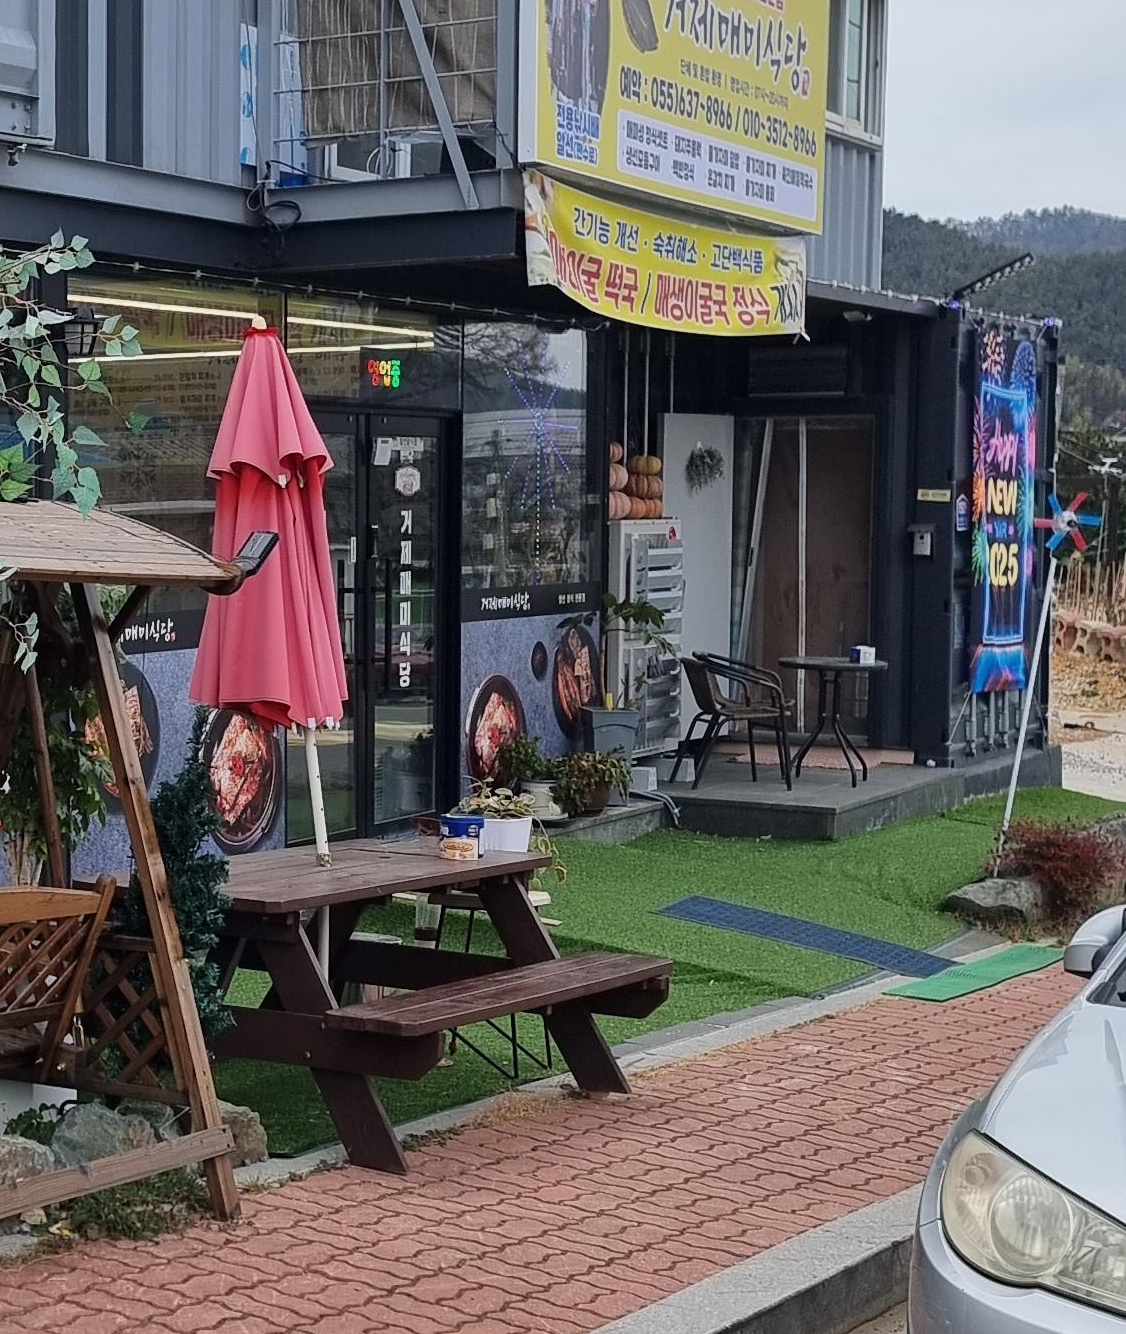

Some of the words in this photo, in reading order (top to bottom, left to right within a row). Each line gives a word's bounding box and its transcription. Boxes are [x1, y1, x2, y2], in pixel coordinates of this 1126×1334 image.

[620, 65, 641, 103] 예약
[651, 77, 733, 131] 055)637-8966
[742, 107, 817, 157] 010-3512-8966
[573, 207, 611, 244] 간기능
[615, 221, 639, 252] 개선
[653, 232, 698, 265] 숙취해소
[710, 244, 764, 274] 고단백식품
[605, 262, 639, 314] 떡국
[654, 273, 731, 326] 매생이굴국
[732, 286, 771, 327] 정식
[367, 359, 401, 388] 영업중
[987, 478, 1018, 516] NEW
[987, 542, 1019, 587] 025
[399, 509, 413, 688] 거제매미식당
[480, 591, 530, 611] 거제매미식당
